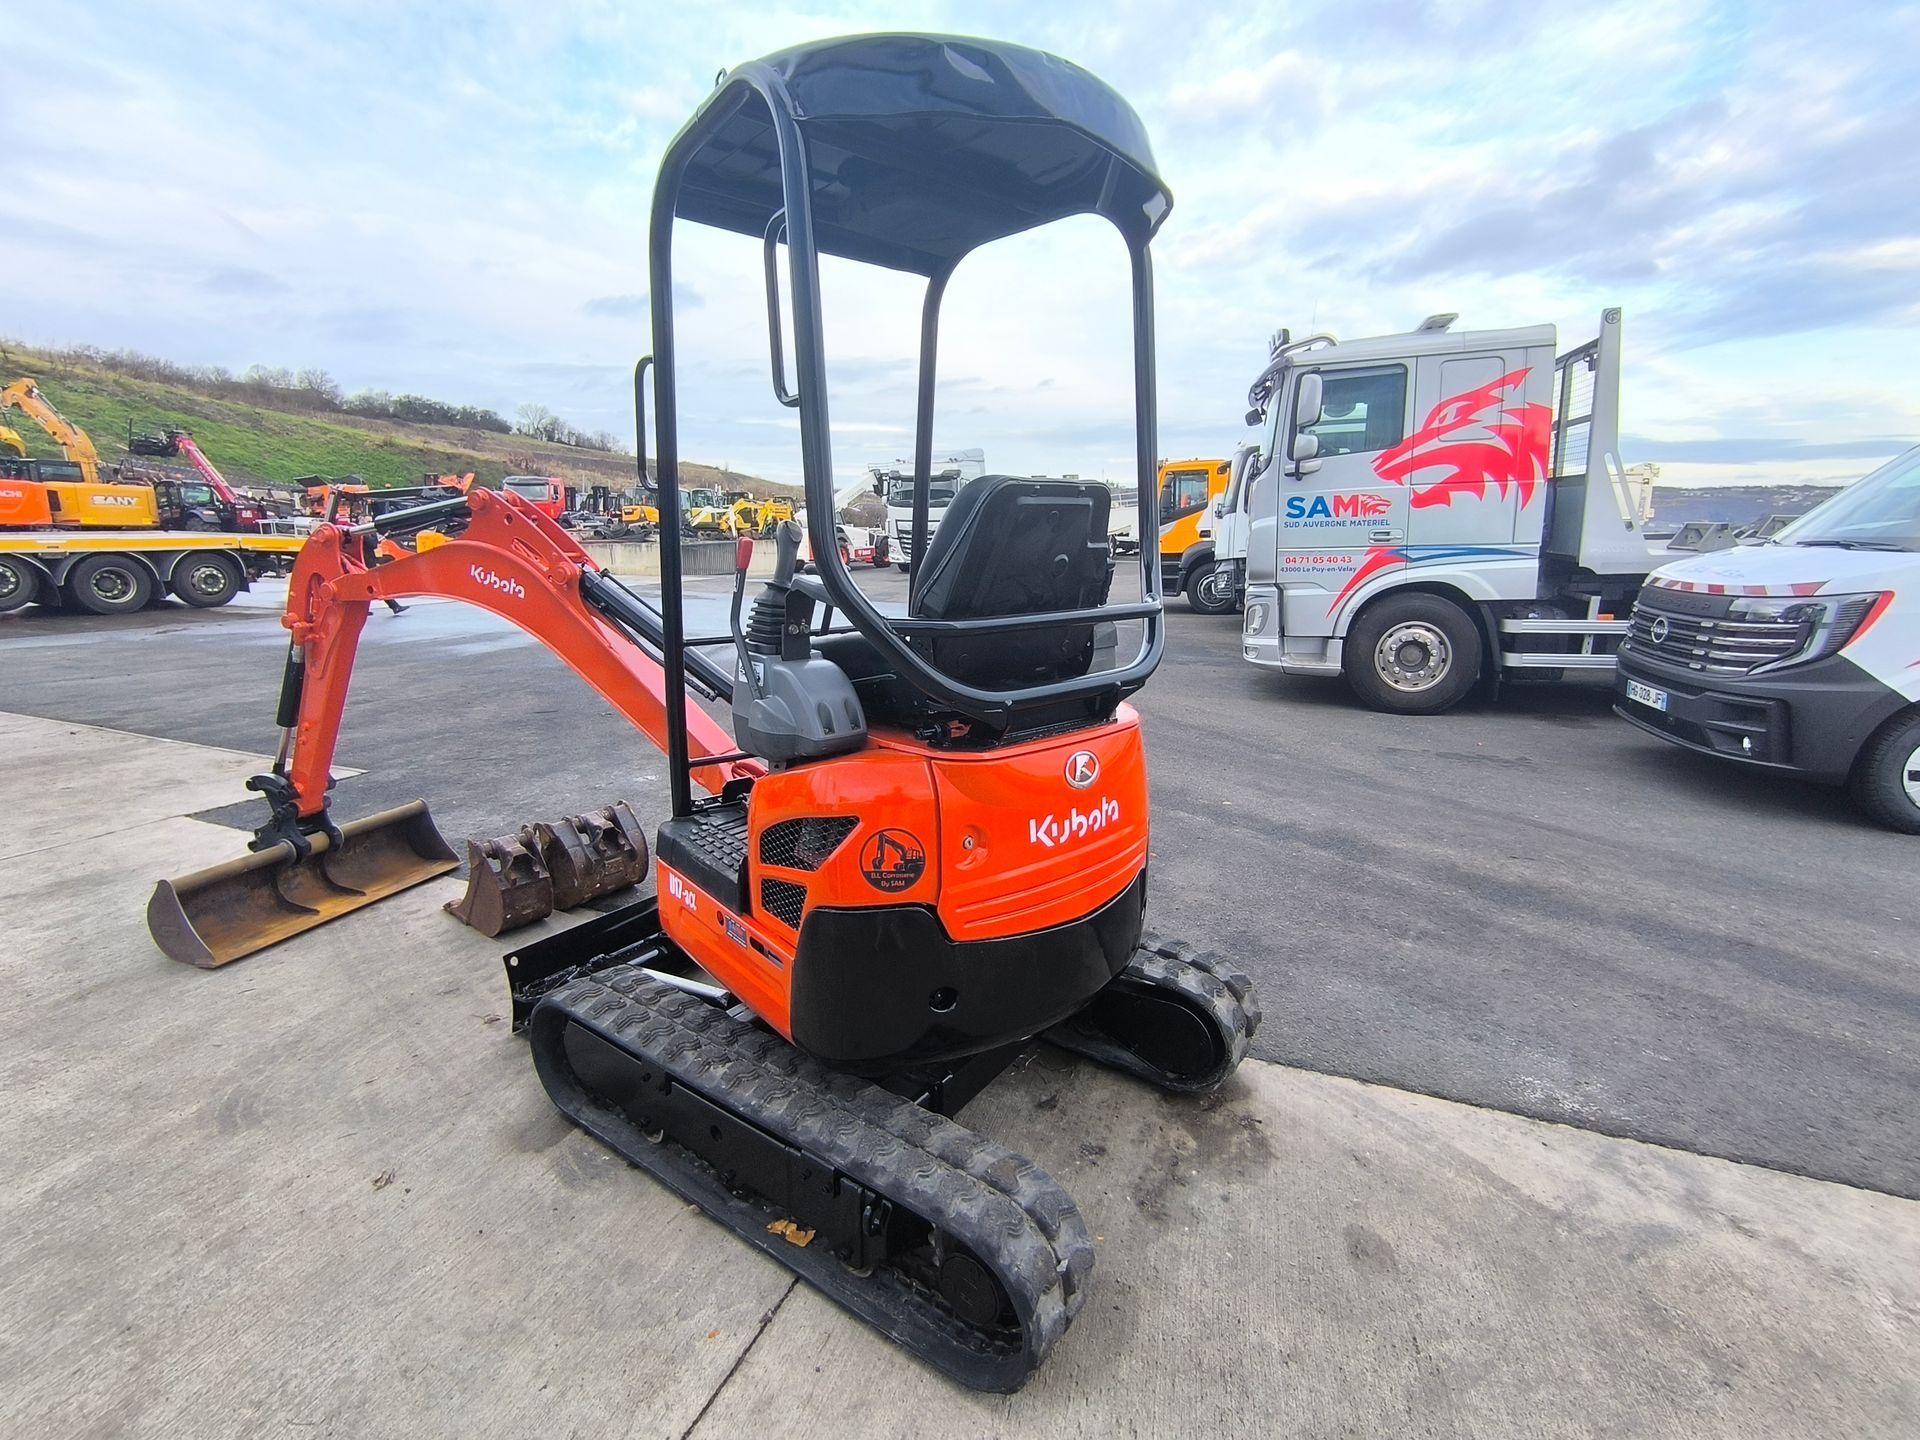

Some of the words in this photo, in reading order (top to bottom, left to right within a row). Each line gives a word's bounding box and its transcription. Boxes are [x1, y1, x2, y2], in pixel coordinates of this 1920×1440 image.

[92, 495, 138, 505] SANY
[1285, 495, 1359, 519] SAM
[1302, 520, 1347, 528] AUVERGNE
[1350, 519, 1391, 527] MATERIEL
[1285, 556, 1296, 564] 04
[1299, 556, 1310, 564] 71
[1313, 556, 1324, 564] 05
[1327, 556, 1338, 564] 40
[1340, 556, 1352, 564] 43
[1311, 565, 1357, 574] Puy-en-Velay
[470, 564, 525, 599] Kubota
[1029, 796, 1119, 848] Kubota
